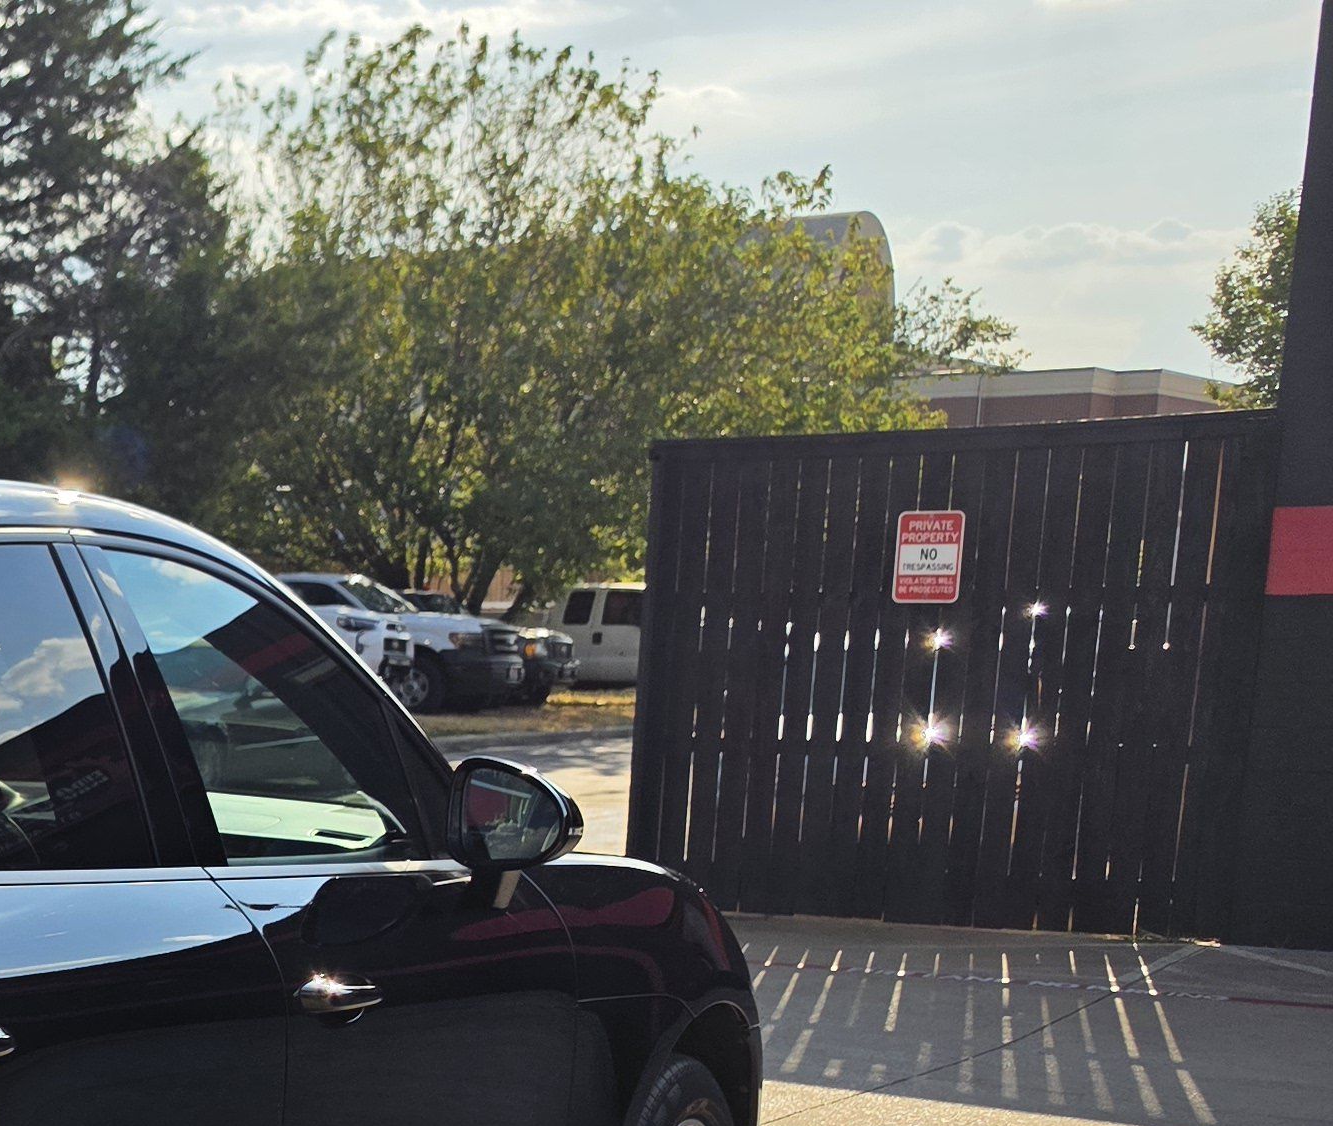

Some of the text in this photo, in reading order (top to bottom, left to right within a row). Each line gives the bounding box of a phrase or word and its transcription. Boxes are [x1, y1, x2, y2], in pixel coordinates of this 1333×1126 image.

[908, 520, 954, 531] PRIVATE
[901, 531, 960, 543] PROPERTY
[919, 548, 938, 561] NO
[902, 562, 954, 572] TRESPASSING
